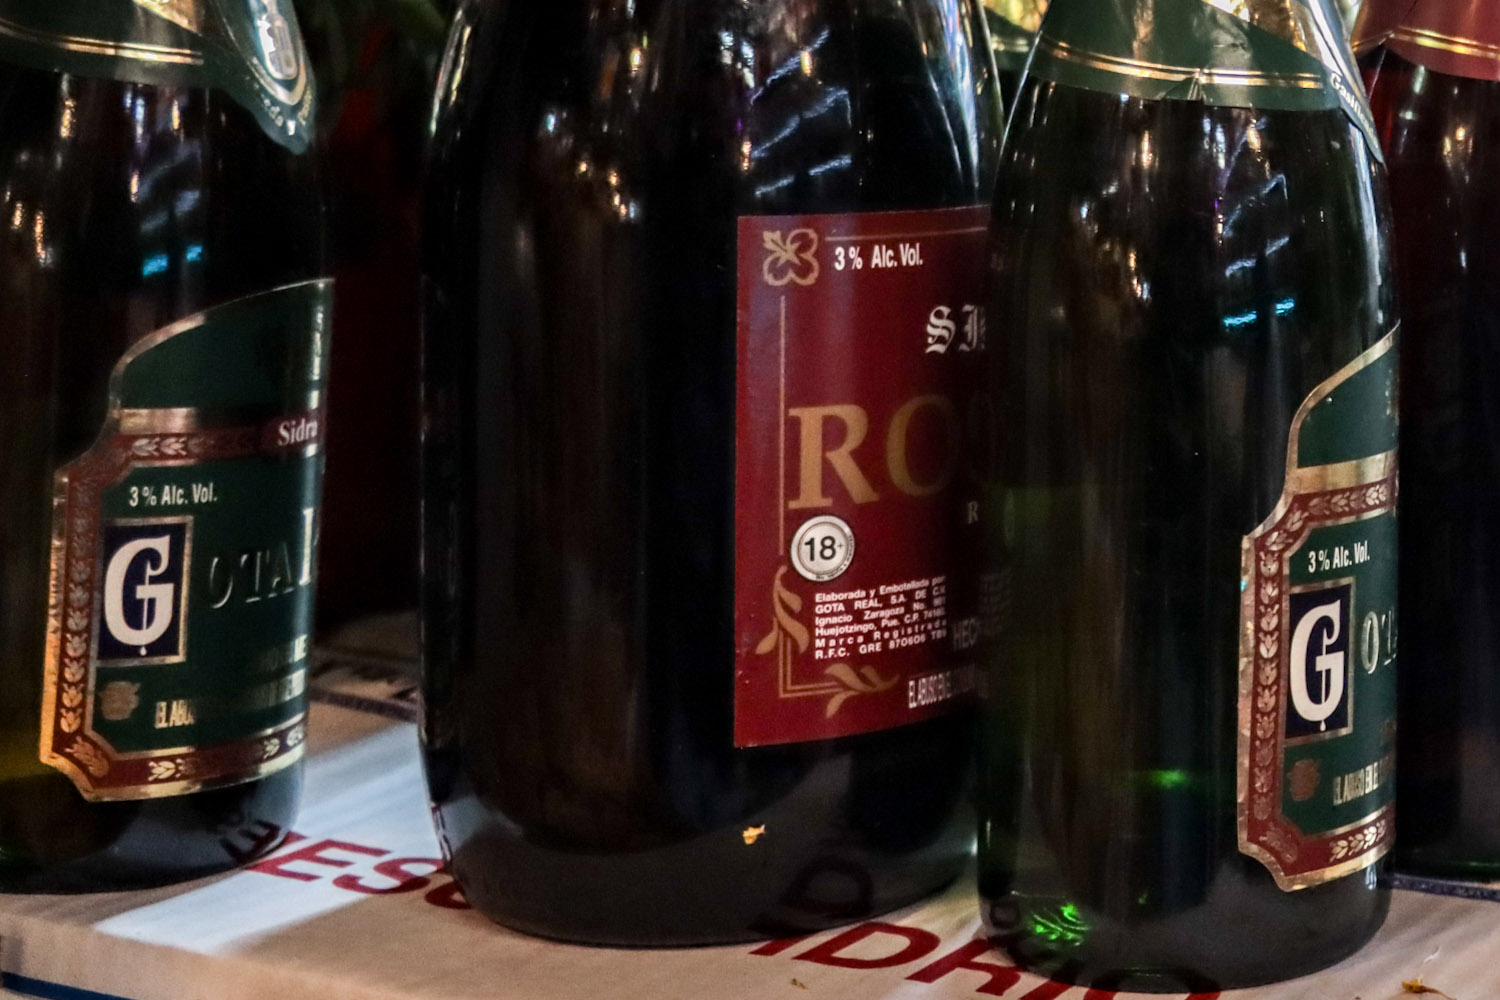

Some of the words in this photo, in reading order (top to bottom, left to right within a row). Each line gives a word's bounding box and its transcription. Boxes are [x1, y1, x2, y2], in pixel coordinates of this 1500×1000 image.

[834, 246, 845, 271] 3
[848, 245, 863, 270] %
[870, 244, 898, 269] Alc.
[899, 243, 924, 266] Vol.
[278, 419, 319, 447] Sidra
[129, 486, 140, 507] 3
[142, 486, 157, 507] %
[161, 485, 188, 505] Alc.
[192, 482, 218, 503] Vol.
[1308, 550, 1317, 574] 3
[1318, 549, 1331, 571] %
[1332, 546, 1353, 570] Alc.
[1354, 541, 1371, 565] Vol.
[814, 589, 866, 603] Elaborada
[869, 589, 877, 598] y
[814, 604, 846, 615] GOTA
[854, 599, 883, 611] REAL,
[915, 589, 927, 600] DE
[814, 614, 854, 628] Ignacio
[863, 606, 906, 621] Zaragoza
[814, 621, 877, 638] Huejotzingo,
[814, 634, 865, 649] Marca
[873, 618, 948, 641] Registrada
[814, 647, 851, 660] R.F.C.
[858, 642, 883, 655] GRE
